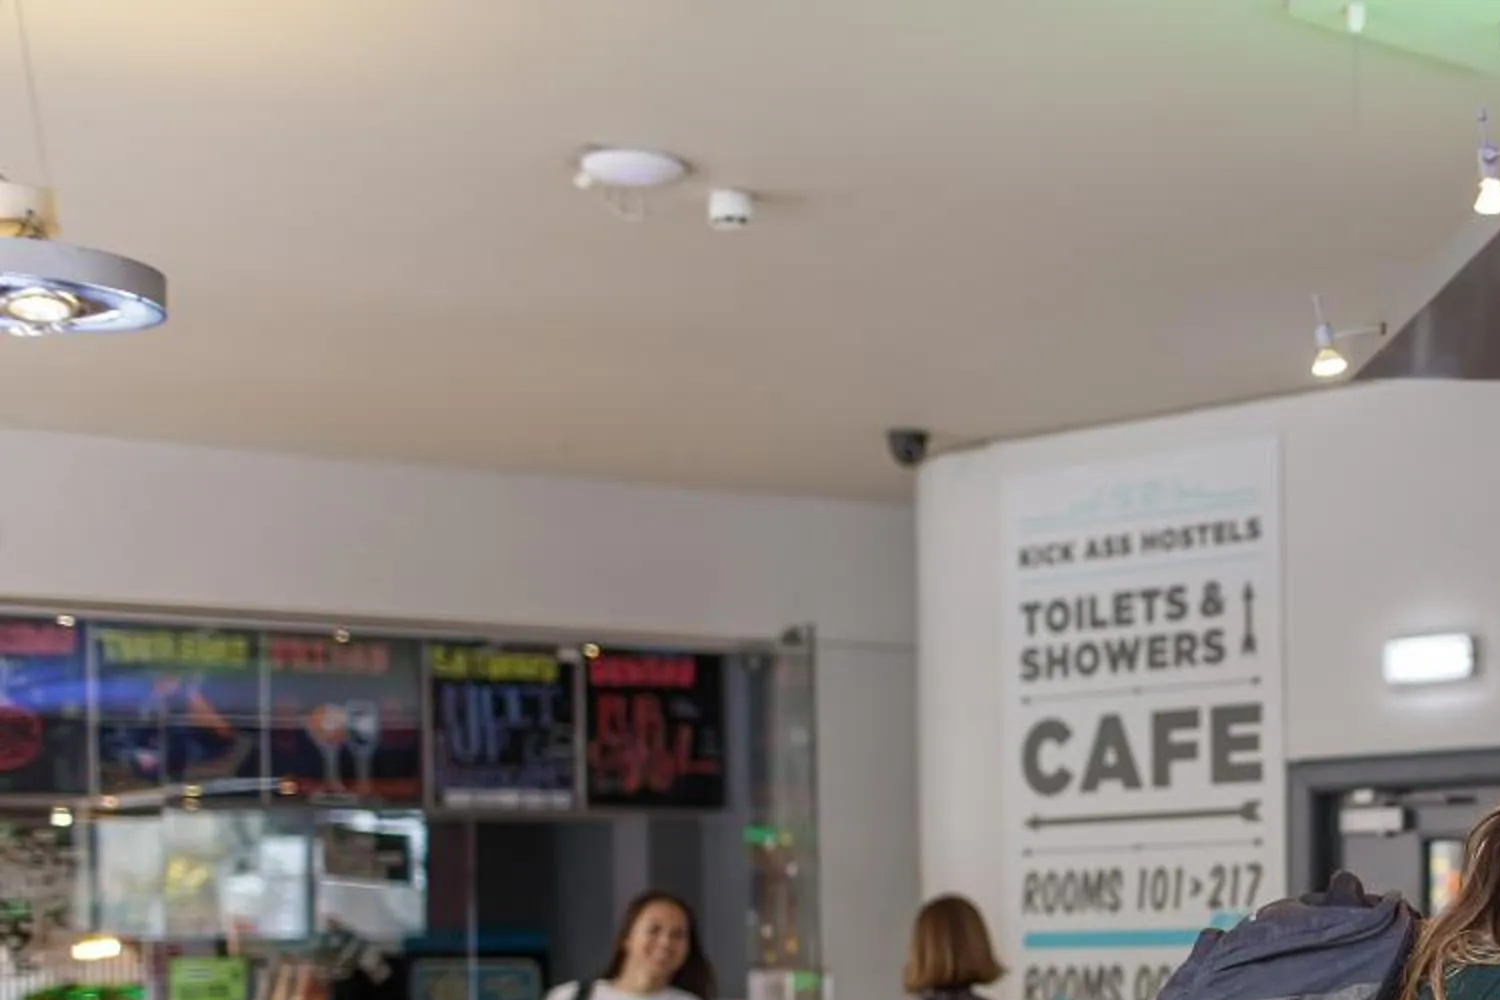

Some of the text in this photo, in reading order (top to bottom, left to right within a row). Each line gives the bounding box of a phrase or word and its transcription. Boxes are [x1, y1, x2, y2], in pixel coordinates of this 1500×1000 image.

[1018, 515, 1262, 569] KICK ASS HOSTELS
[1020, 580, 1225, 636] TOILETS &
[1019, 628, 1227, 683] SHOWERS
[1021, 702, 1264, 798] CAFE
[1023, 865, 1125, 915] ROOMS
